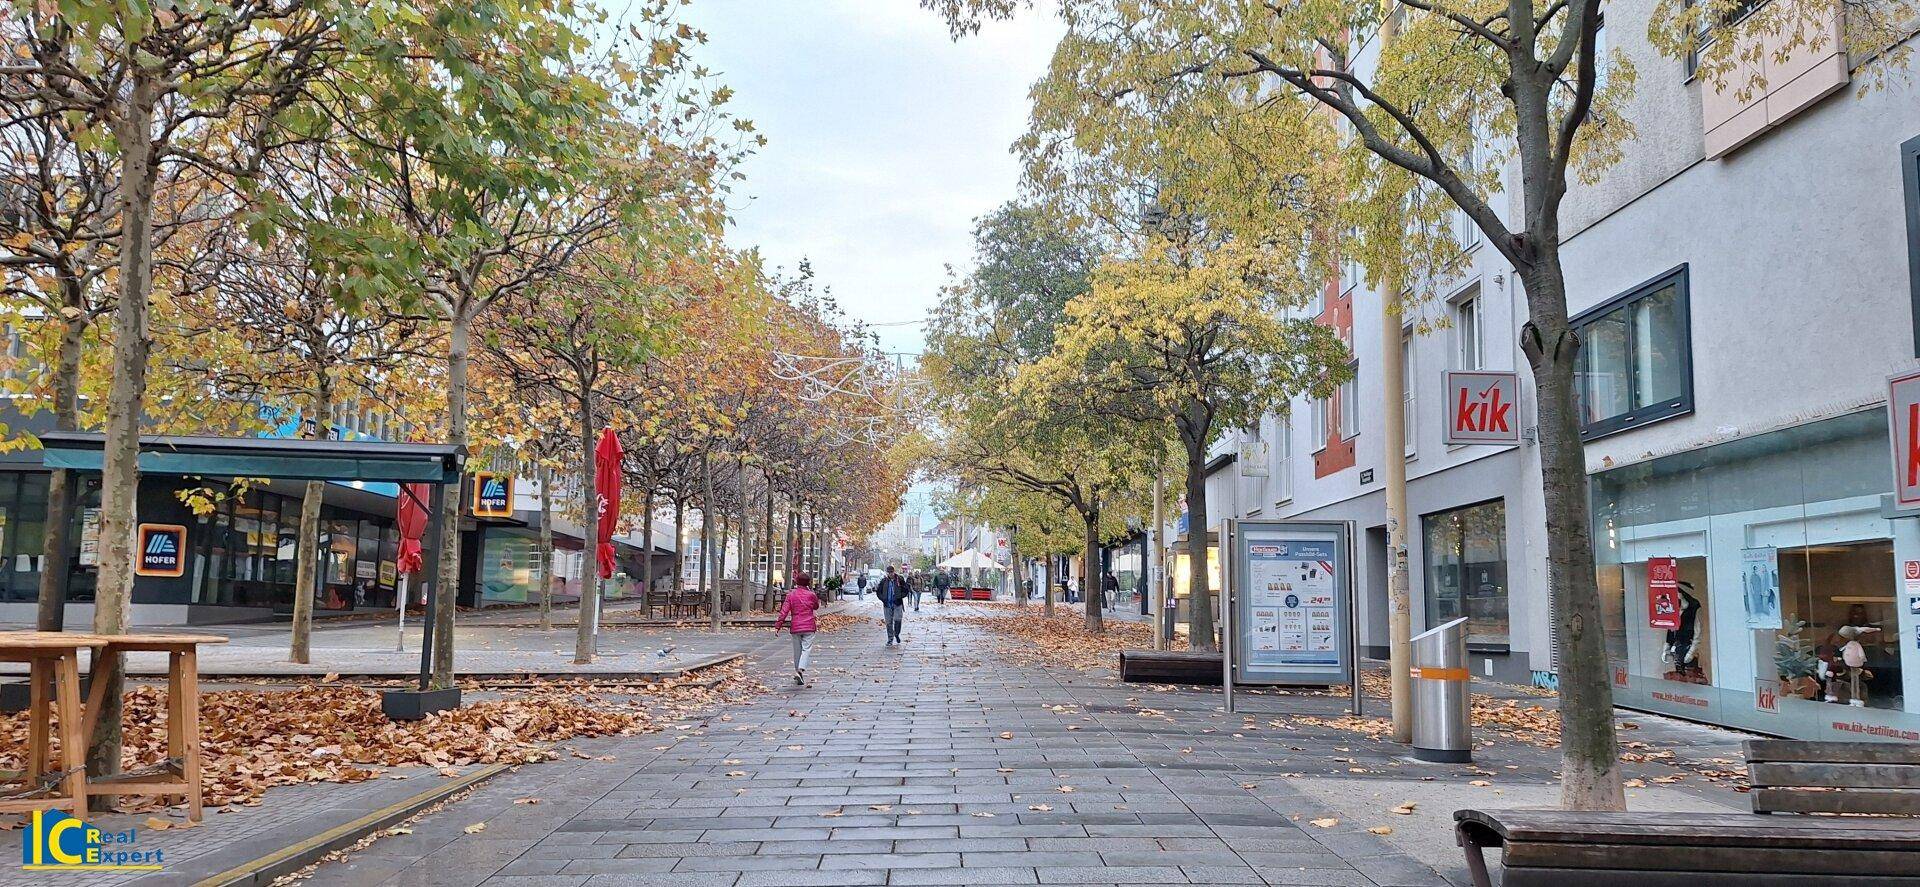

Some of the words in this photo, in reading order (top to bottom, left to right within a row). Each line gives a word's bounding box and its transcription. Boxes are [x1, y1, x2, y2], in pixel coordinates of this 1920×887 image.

[1457, 387, 1511, 432] kik
[481, 498, 506, 506] HOFER
[145, 555, 176, 564] HOFER
[1758, 686, 1775, 709] kik
[1832, 721, 1919, 740] www.kik-textilien.com
